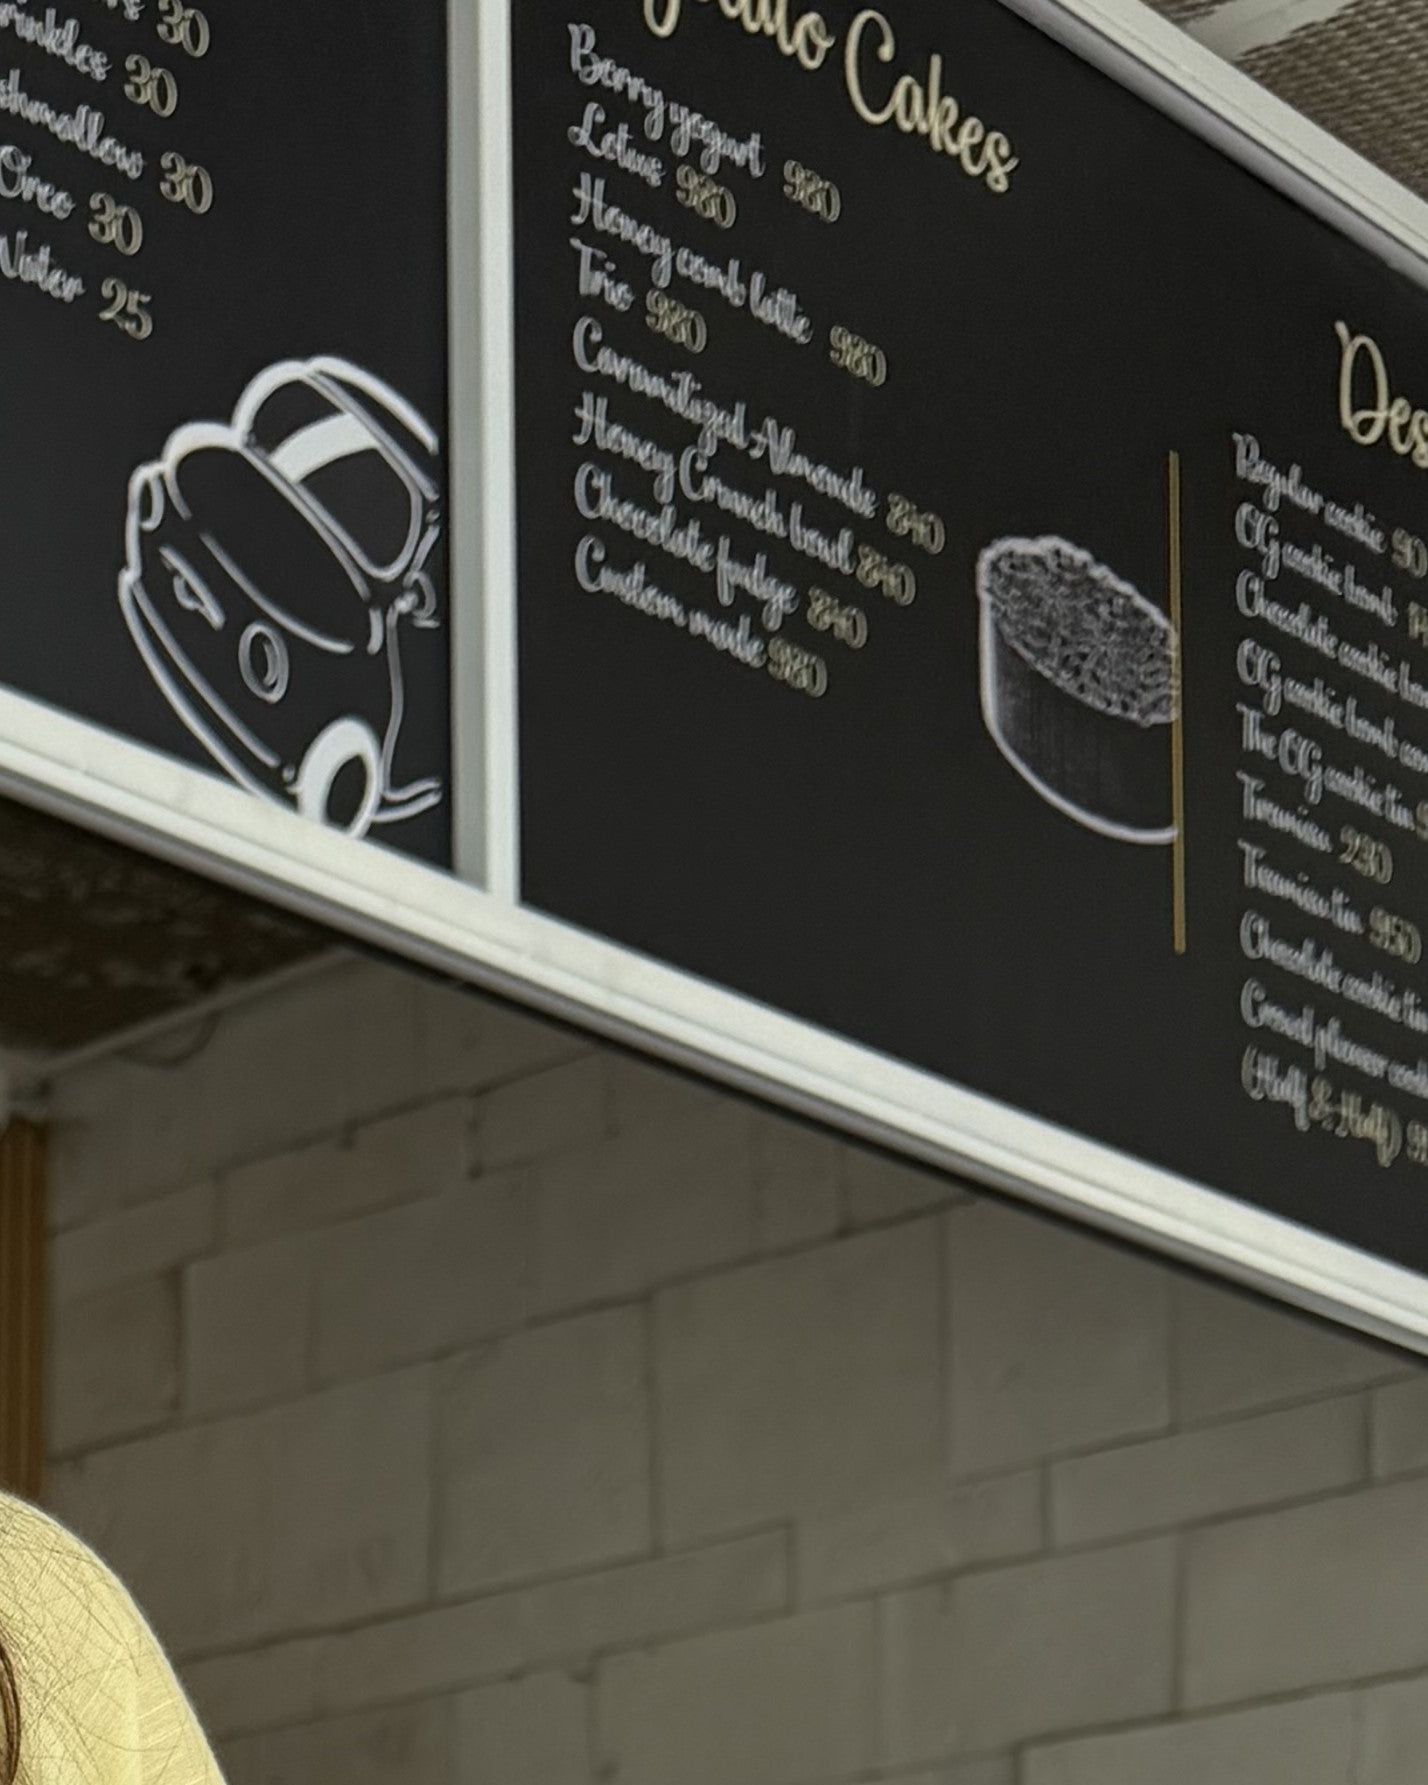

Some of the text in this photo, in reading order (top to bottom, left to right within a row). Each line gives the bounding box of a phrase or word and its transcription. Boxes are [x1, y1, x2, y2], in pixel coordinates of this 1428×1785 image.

[124, 54, 178, 118] 30
[156, 0, 210, 57] 30
[567, 22, 842, 224] Berry yogurt 980
[844, 9, 1020, 194] Cakes
[87, 192, 143, 256] 30
[159, 152, 213, 214] 30
[567, 102, 737, 230] Lotus 980
[99, 277, 153, 341] 25
[569, 237, 708, 355] Trio 980
[570, 171, 675, 290] Honey
[749, 271, 814, 346] latte
[829, 325, 887, 388] 980
[572, 390, 677, 505] Honey
[678, 445, 789, 539] Crunch
[855, 543, 917, 607] 840
[749, 416, 880, 520] Almonds
[886, 492, 945, 555] 840
[1232, 431, 1325, 513] Regular
[1323, 502, 1388, 554] cookie
[574, 461, 869, 650] Chocolate fudge 840
[1282, 541, 1343, 597] cookie
[574, 533, 828, 698] Custom made 980
[1236, 568, 1339, 660] Chocolate
[1338, 640, 1400, 694] cookie
[1235, 702, 1279, 761] The
[1322, 764, 1385, 817] cookie
[1283, 676, 1345, 729] cookie
[1236, 769, 1335, 853] Tiramisu
[1237, 837, 1331, 921] Tiramisu
[1240, 908, 1343, 994] Chocolate
